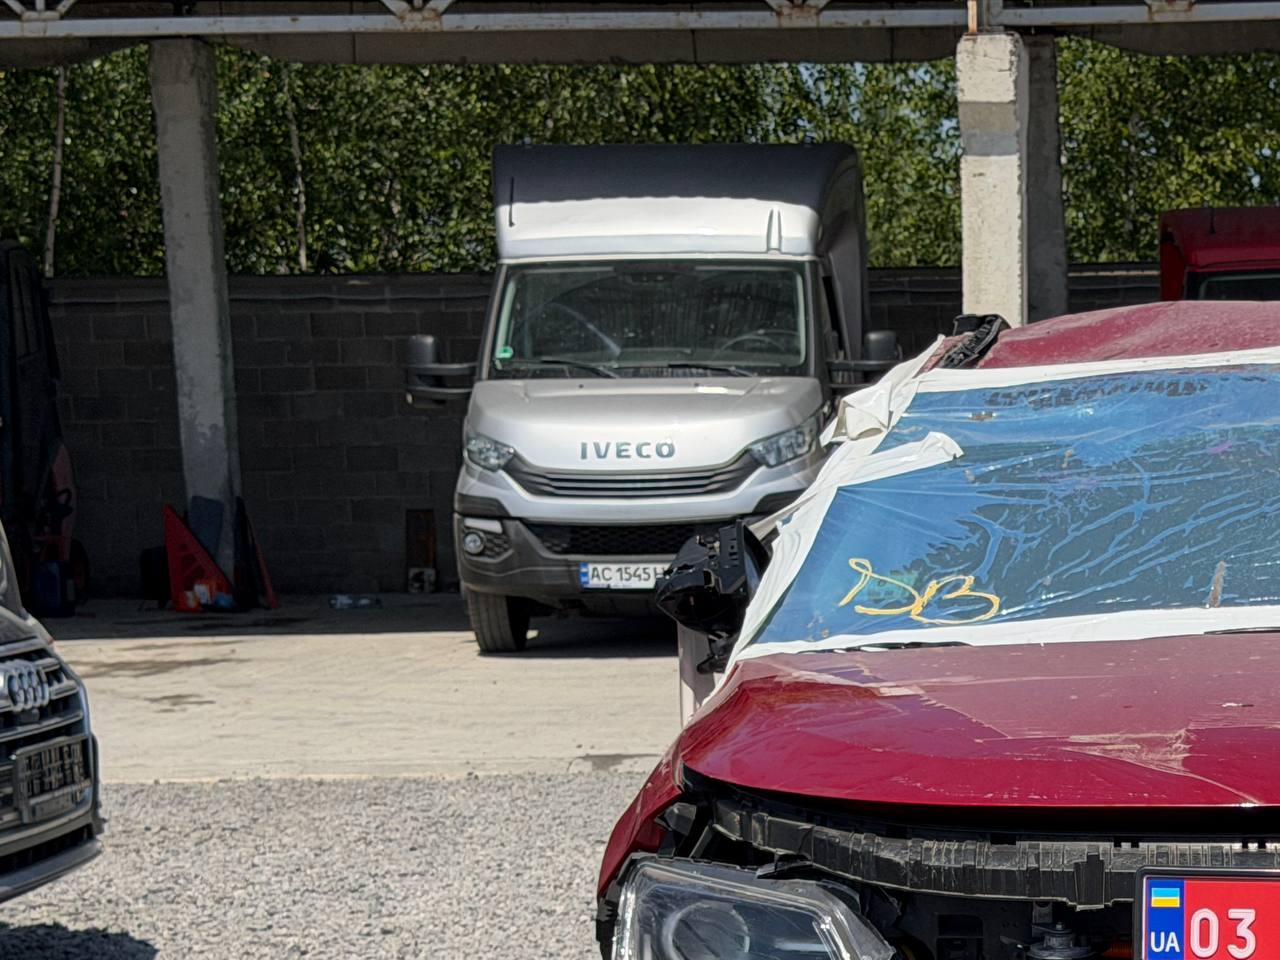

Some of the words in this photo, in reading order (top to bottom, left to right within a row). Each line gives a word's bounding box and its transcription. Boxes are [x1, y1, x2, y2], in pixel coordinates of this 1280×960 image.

[580, 441, 676, 460] IVECO
[591, 567, 613, 582] AC
[616, 566, 652, 582] 1545
[1150, 931, 1181, 953] UA
[1190, 908, 1257, 960] 03
